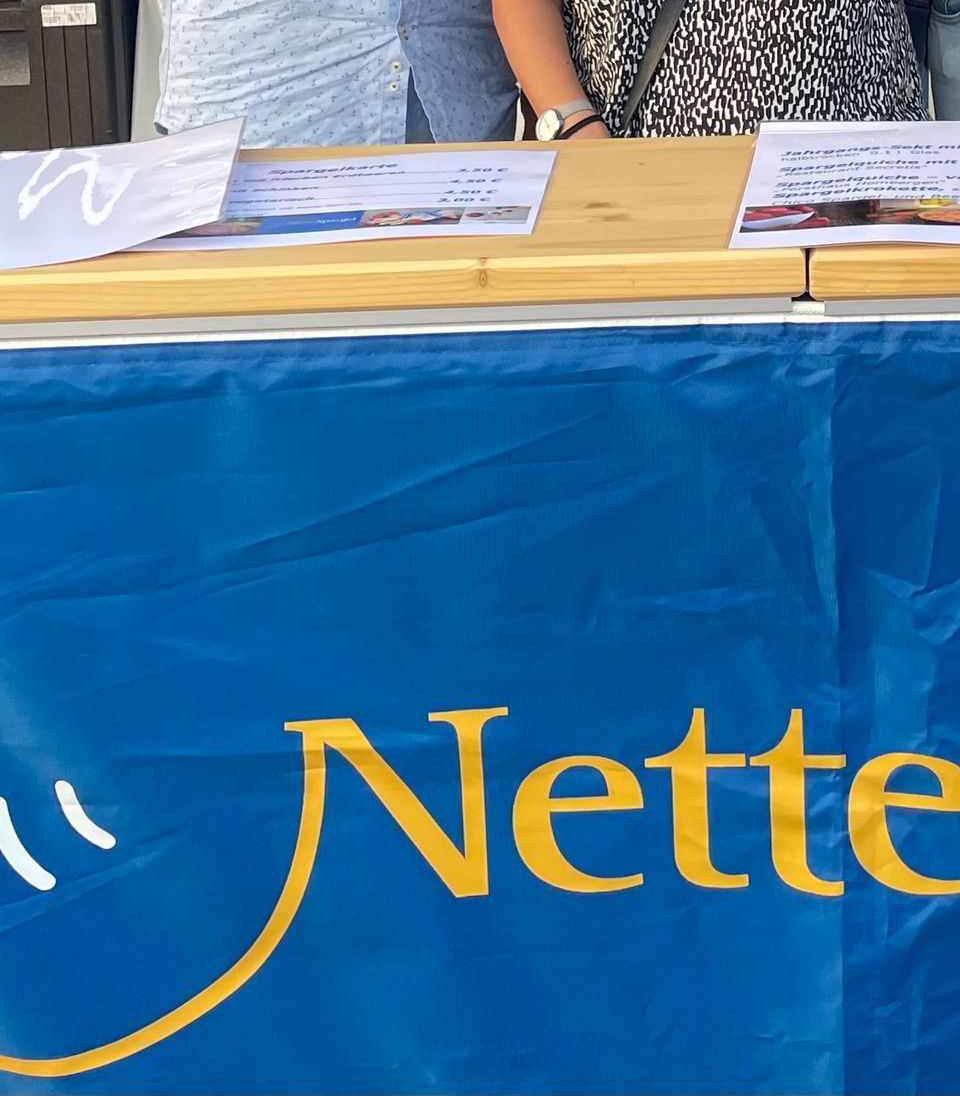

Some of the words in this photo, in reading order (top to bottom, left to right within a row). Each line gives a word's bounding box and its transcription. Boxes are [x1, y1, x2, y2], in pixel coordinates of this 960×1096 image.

[780, 144, 932, 157] Jahrgangs-Sekt
[778, 159, 920, 173] Spargelquiche
[775, 174, 920, 188] Spargelquiche
